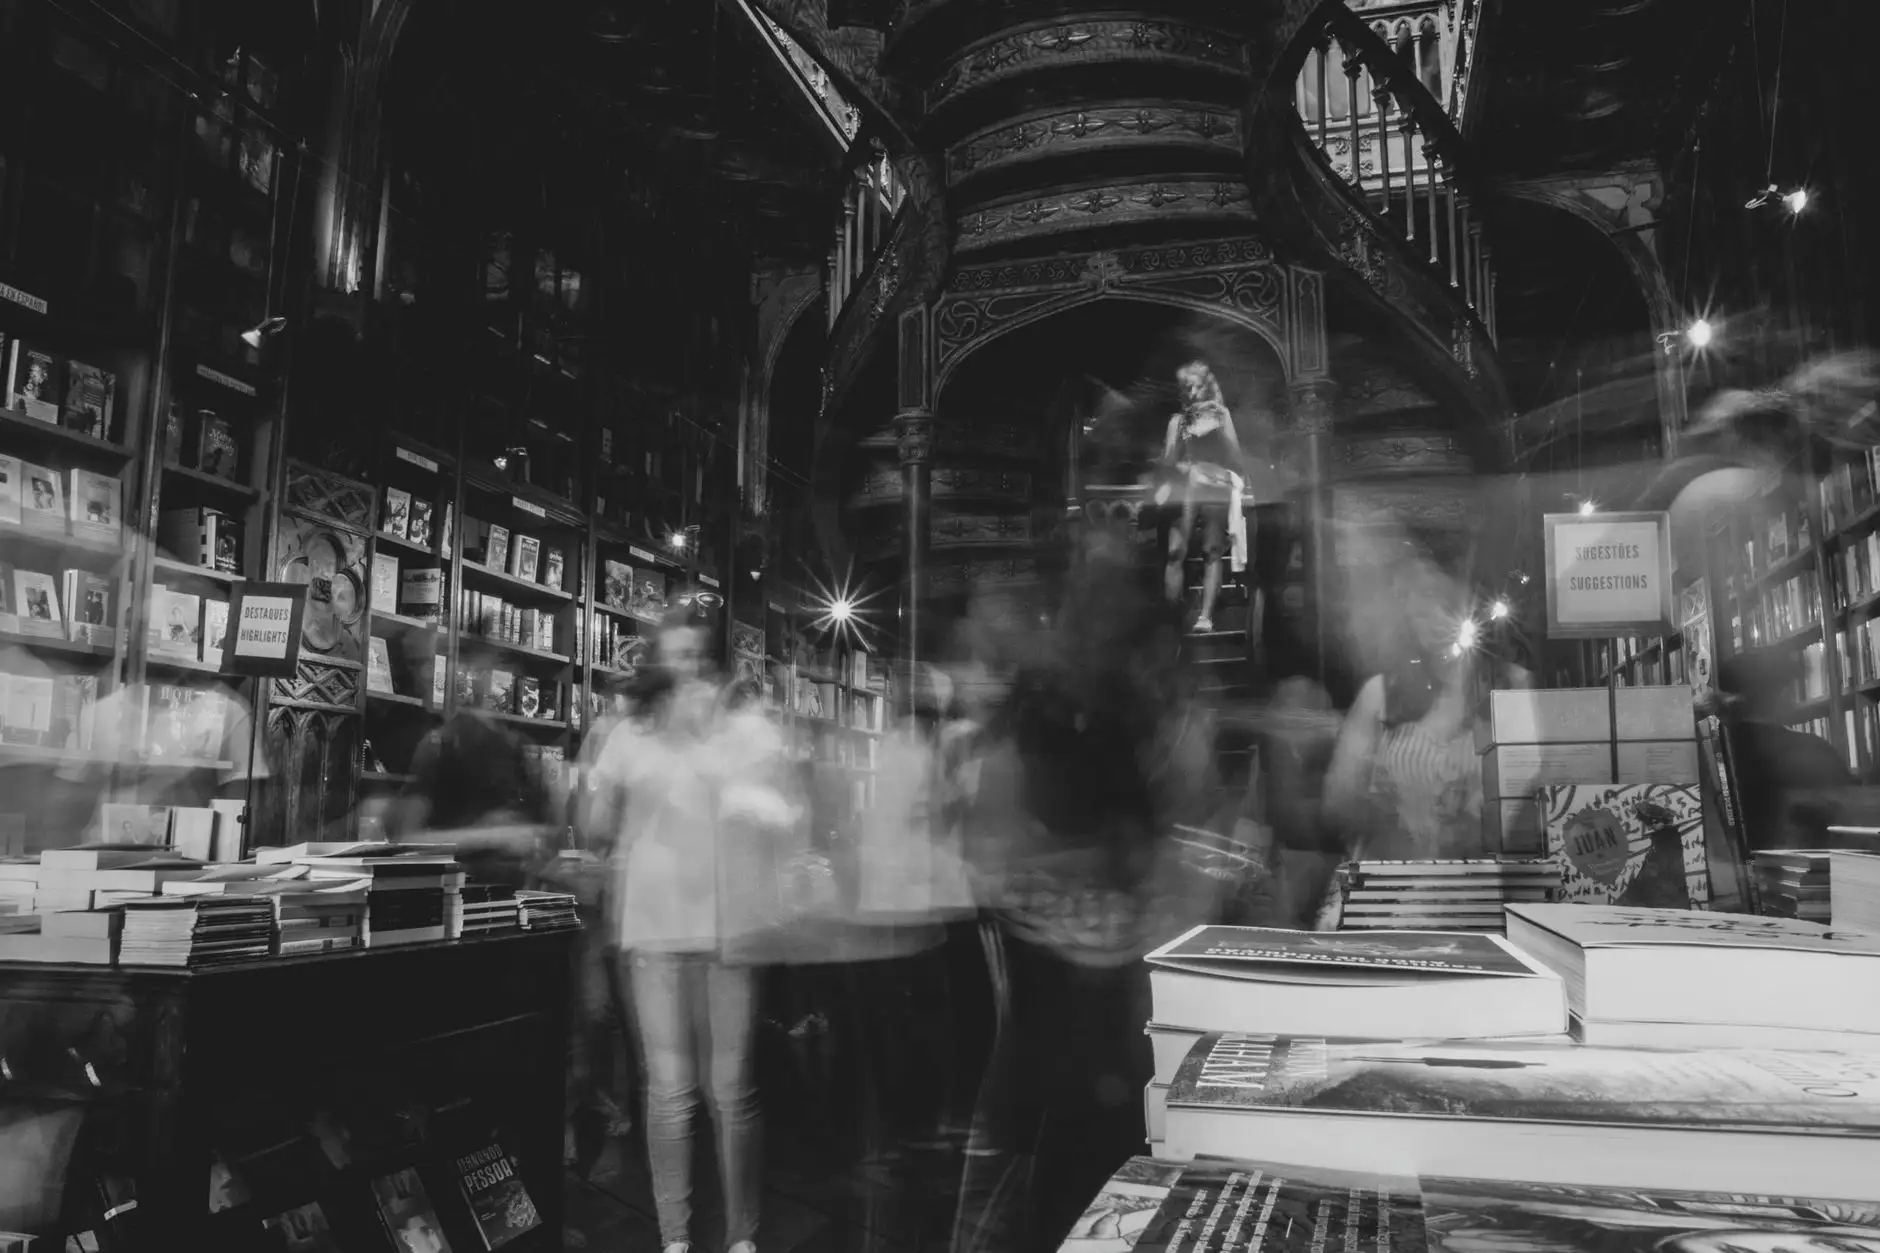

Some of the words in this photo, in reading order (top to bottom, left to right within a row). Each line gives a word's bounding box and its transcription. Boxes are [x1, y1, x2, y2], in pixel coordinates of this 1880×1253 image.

[1575, 543, 1640, 560] SUGESTÕES
[1570, 575, 1647, 590] SUGGESTIONS
[245, 607, 289, 620] DESTAQUES
[241, 629, 286, 643] HIGHLIGHTS
[464, 1158, 513, 1194] PESSOA
